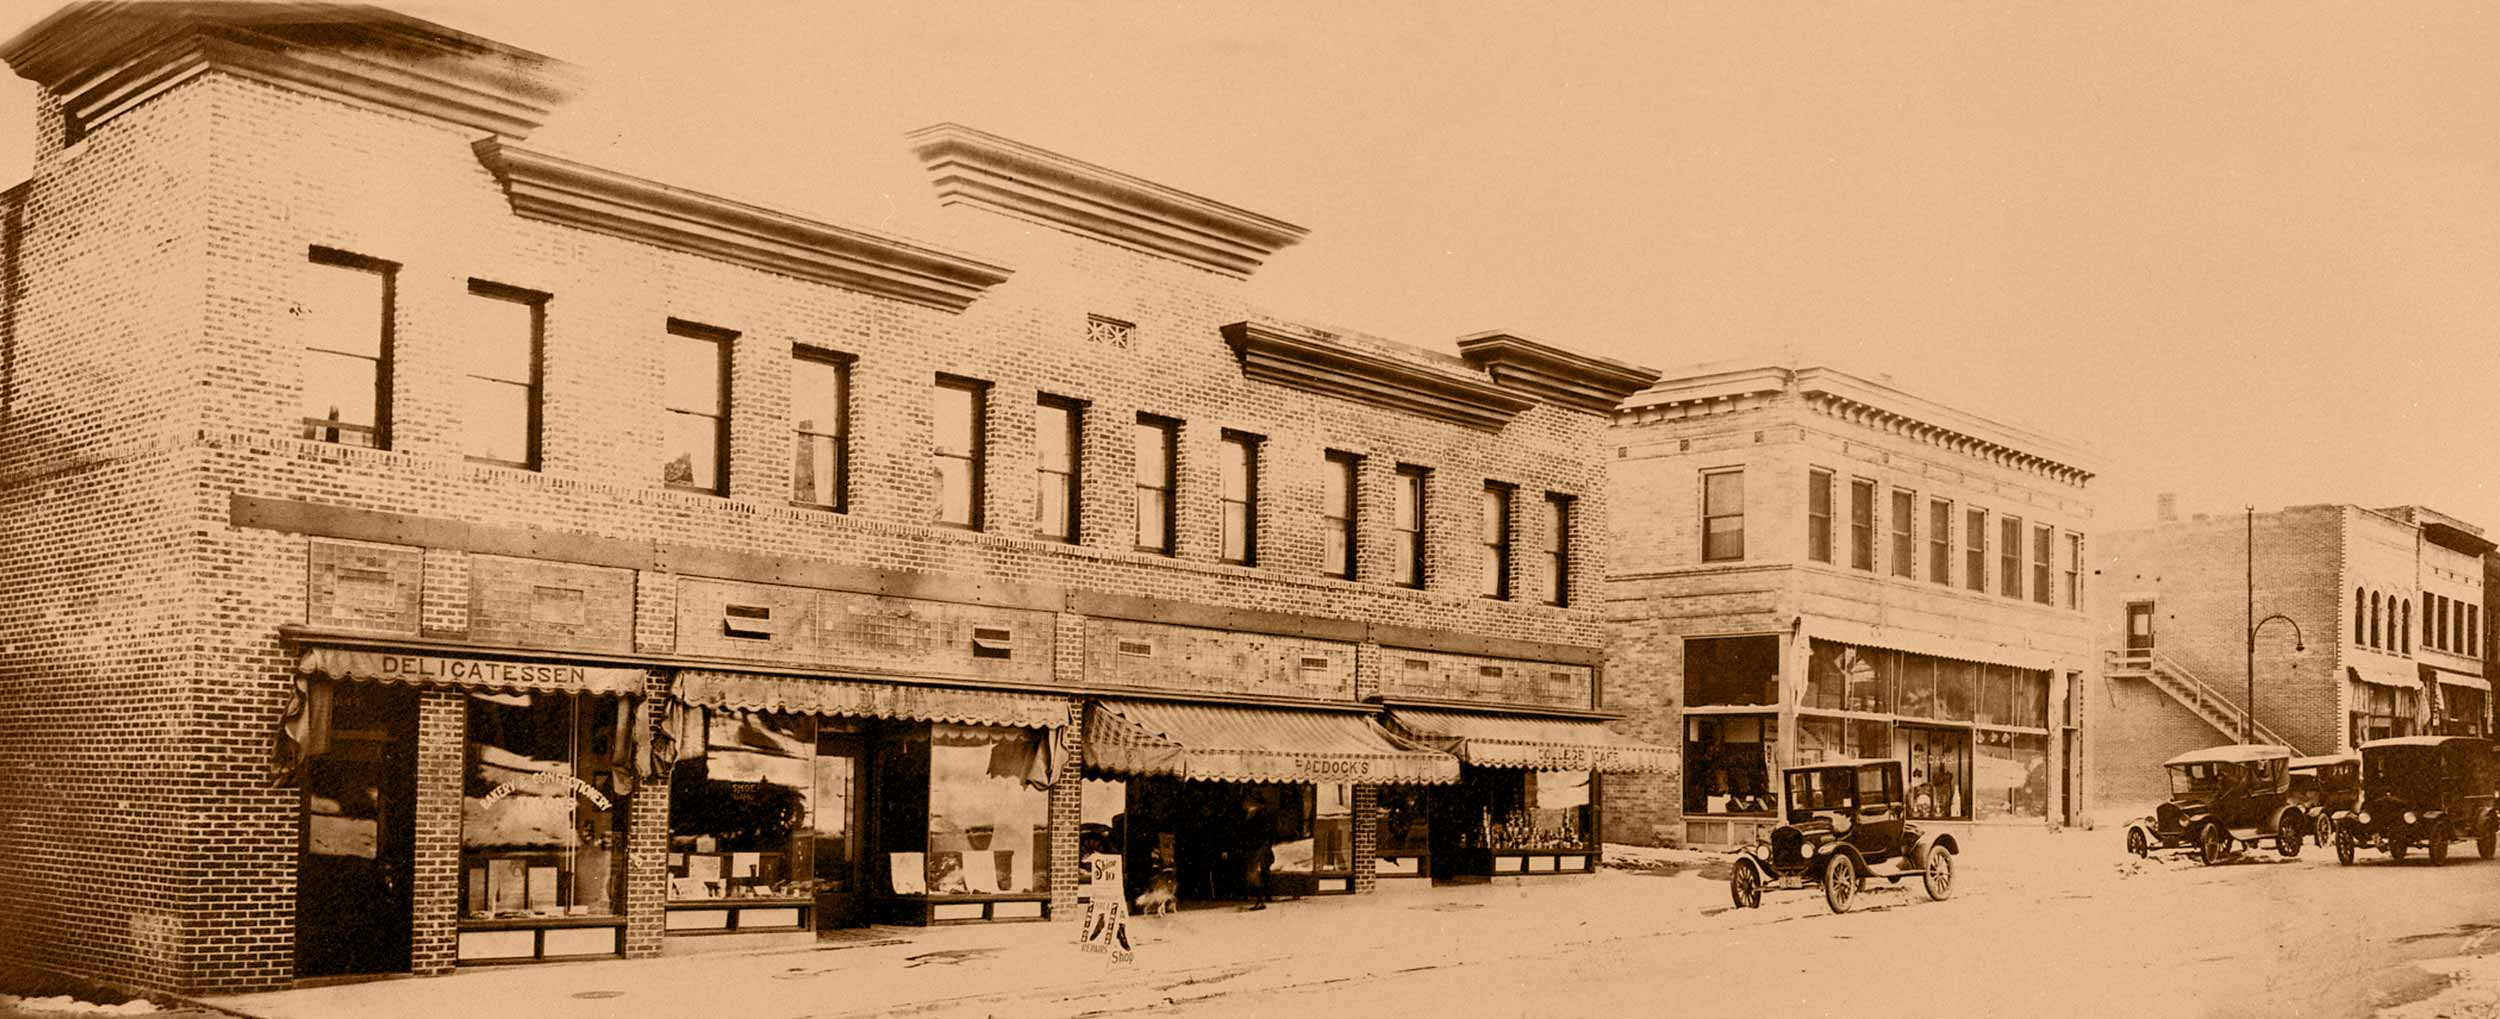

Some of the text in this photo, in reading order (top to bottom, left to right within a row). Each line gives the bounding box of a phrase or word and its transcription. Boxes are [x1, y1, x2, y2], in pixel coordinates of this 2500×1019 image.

[382, 656, 585, 683] DELICATESSEN
[479, 779, 515, 810] BAKERY
[532, 771, 613, 811] CONFECTIONERY
[1112, 950, 1134, 965] Shop
